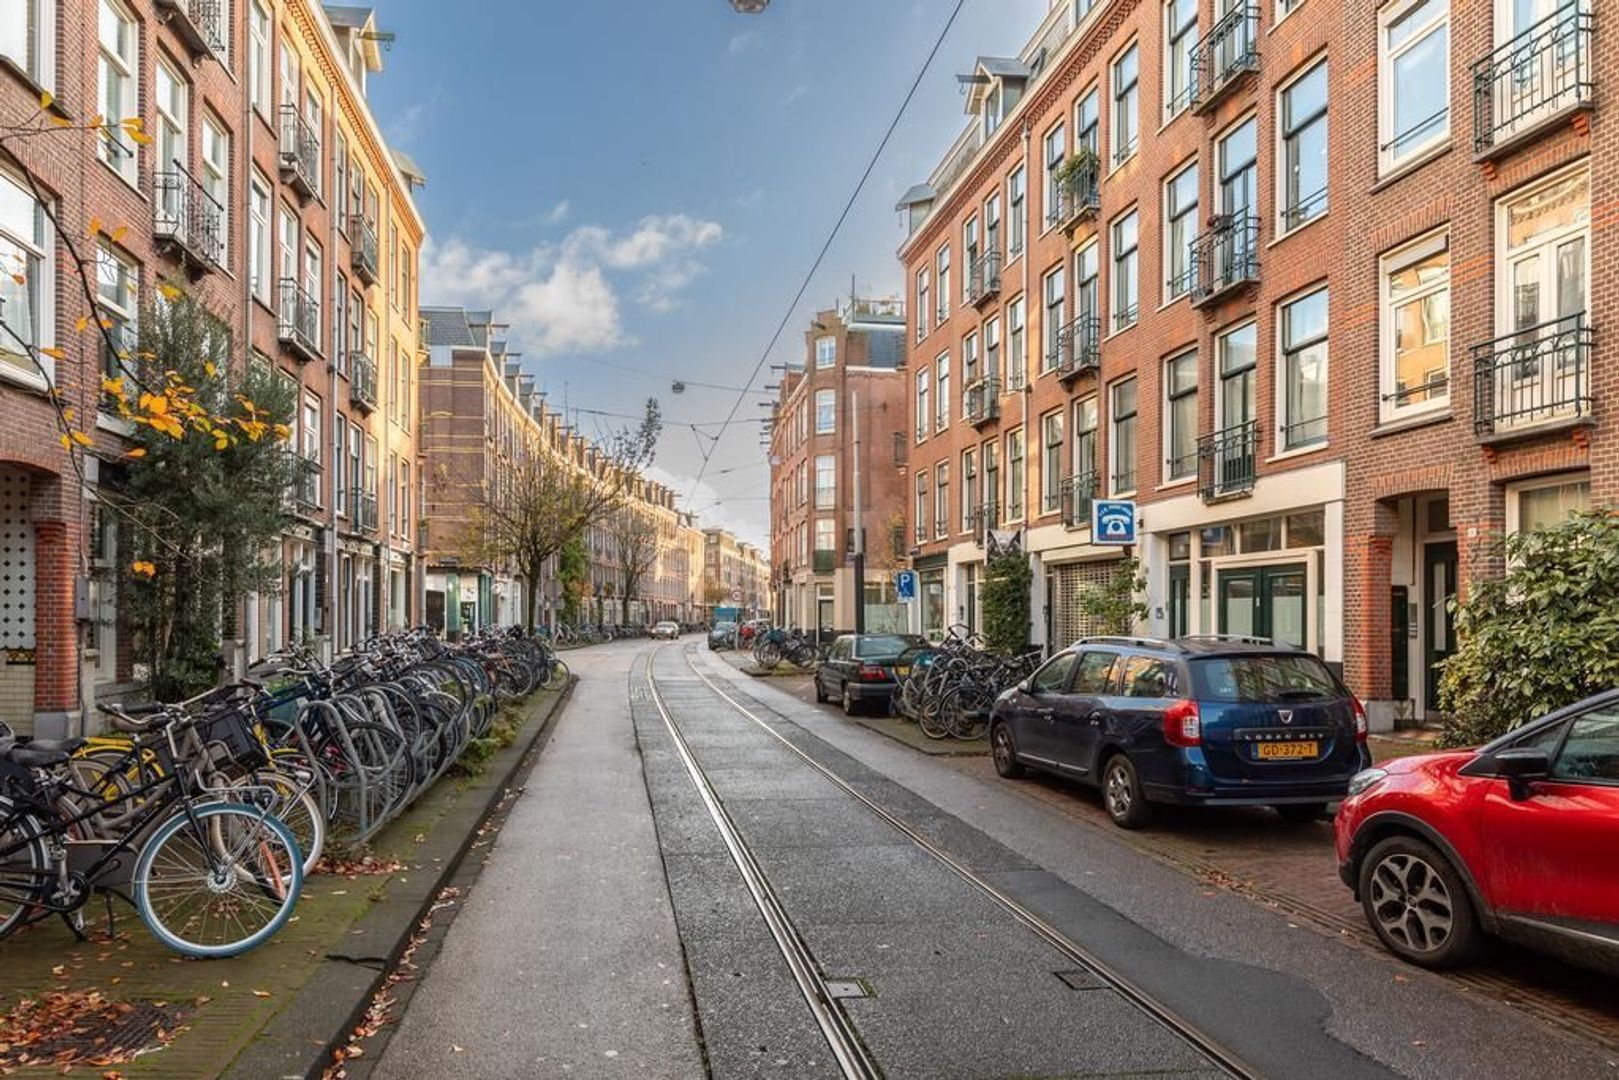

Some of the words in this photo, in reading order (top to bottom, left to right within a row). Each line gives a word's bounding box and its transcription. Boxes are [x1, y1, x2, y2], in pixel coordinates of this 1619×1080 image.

[900, 574, 911, 587] P
[1244, 733, 1292, 741] LOGAN
[1263, 743, 1314, 756] GD-372-T
